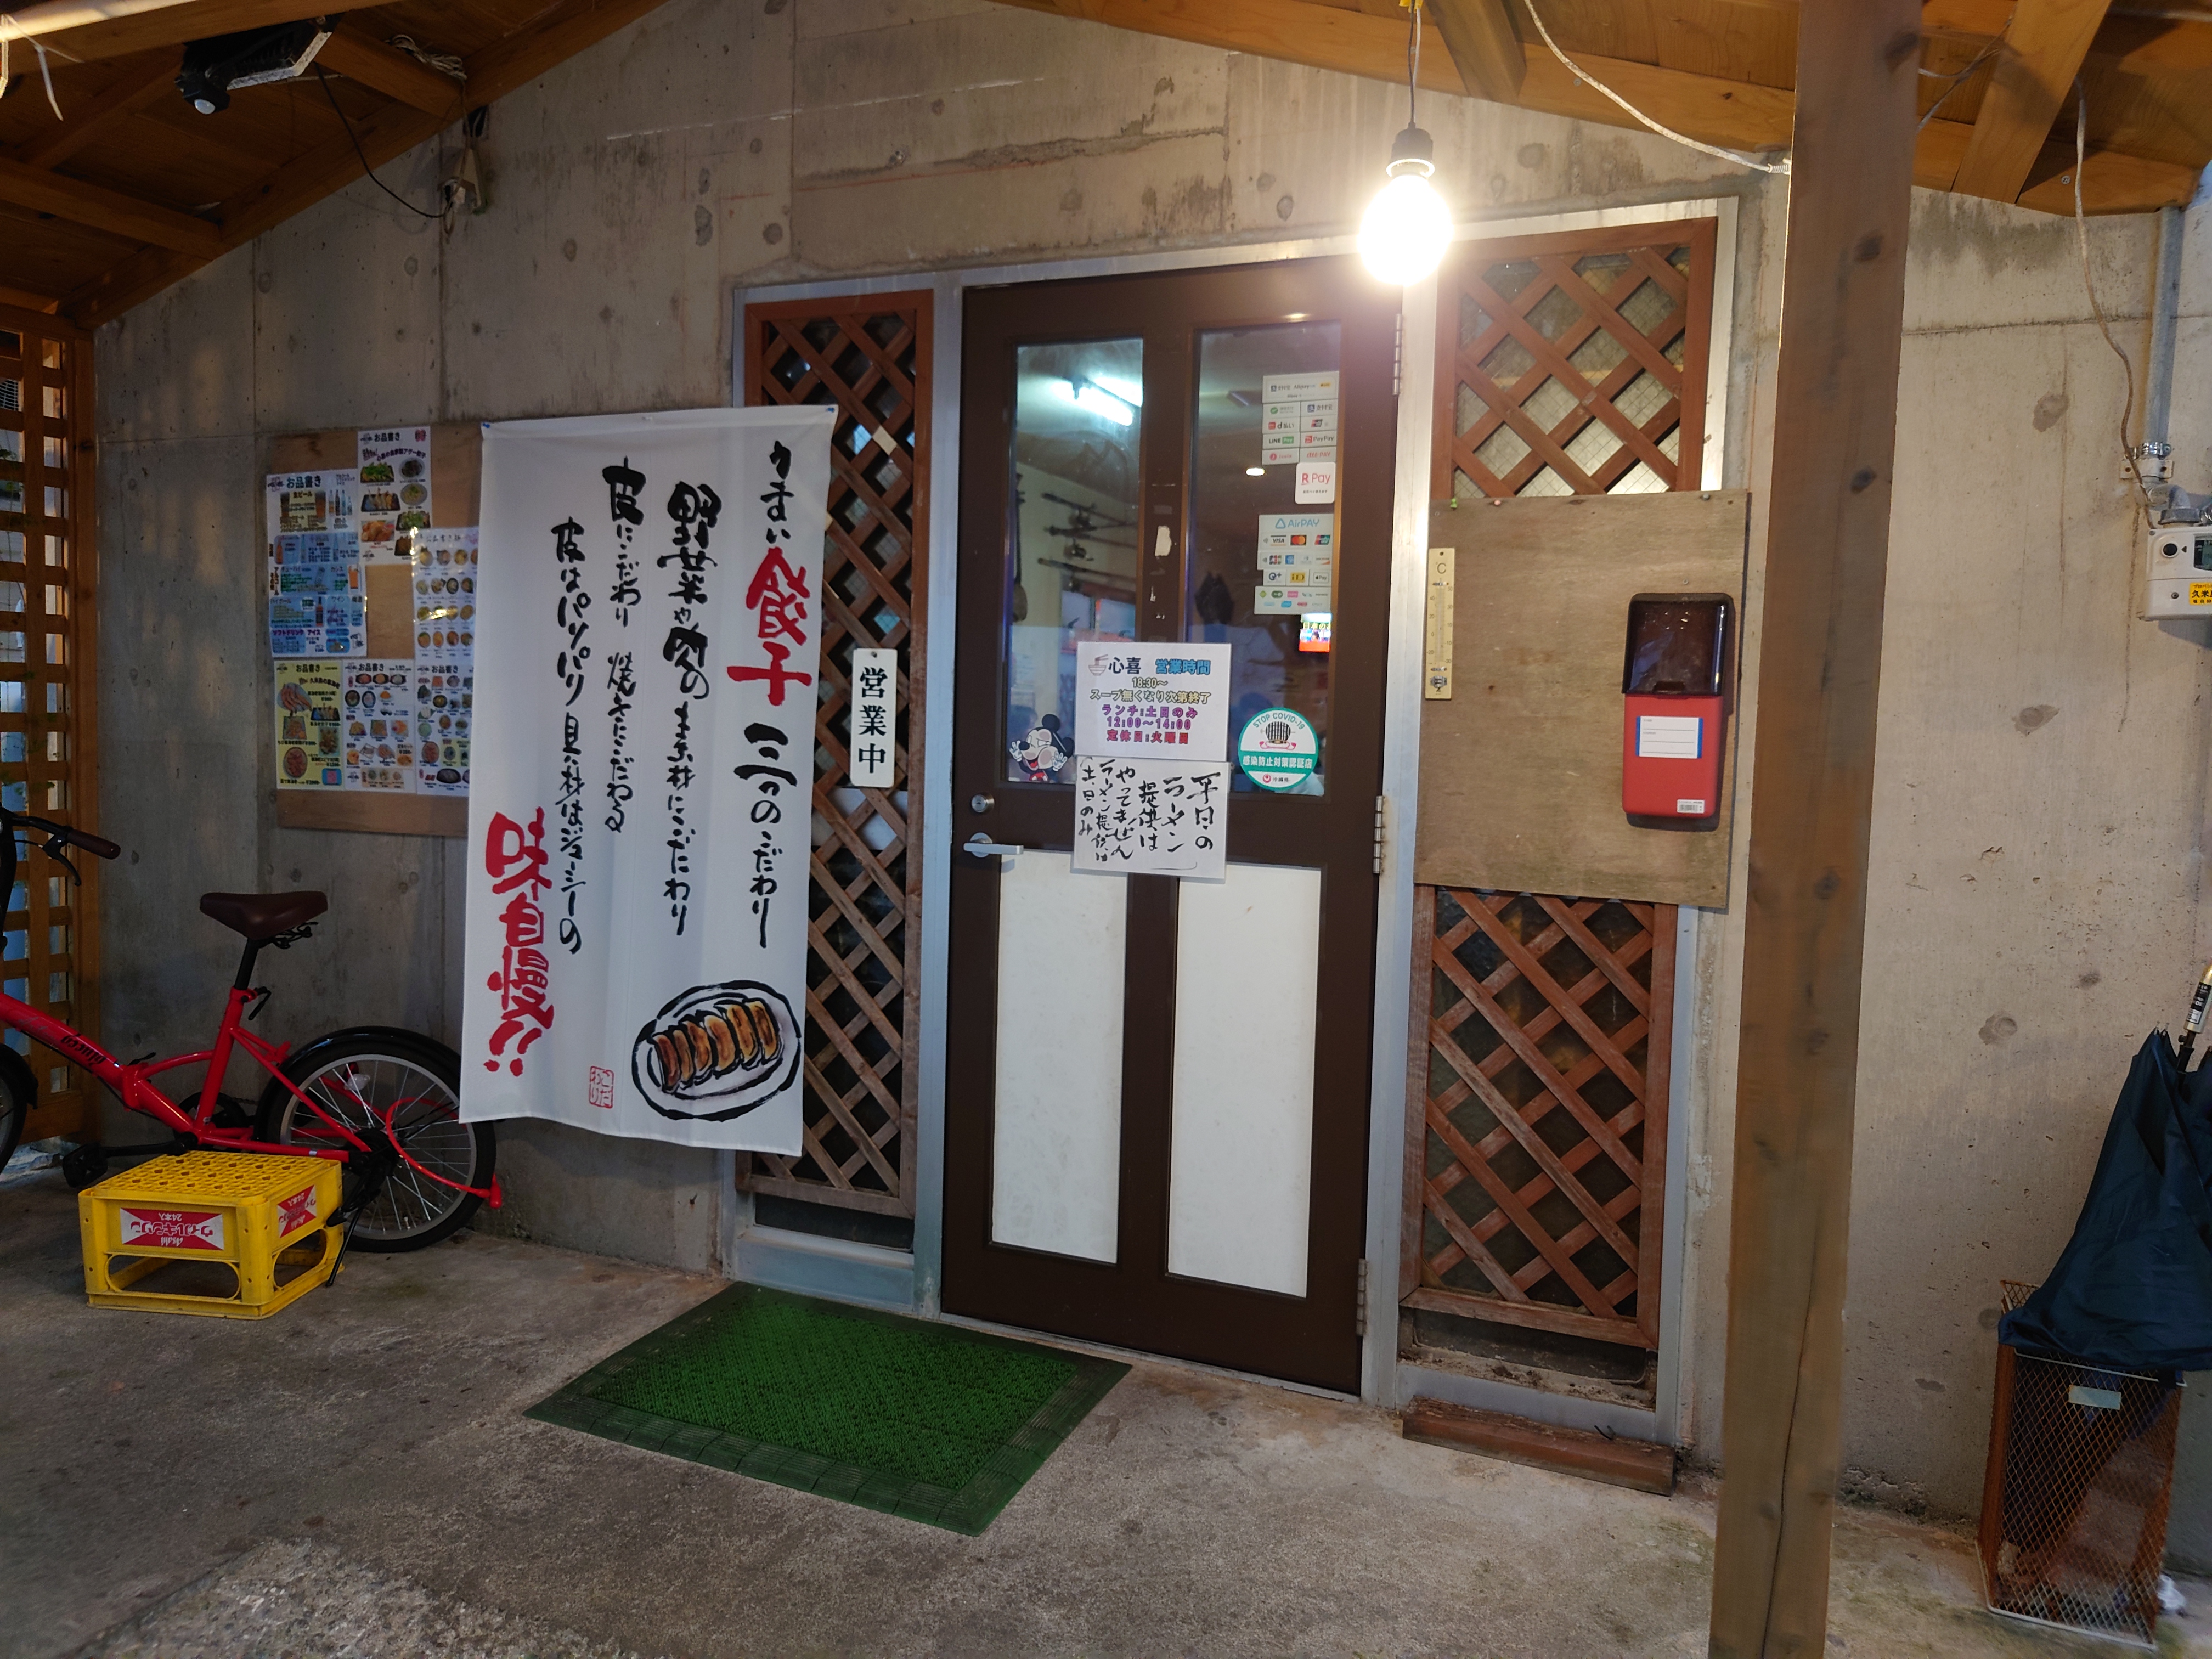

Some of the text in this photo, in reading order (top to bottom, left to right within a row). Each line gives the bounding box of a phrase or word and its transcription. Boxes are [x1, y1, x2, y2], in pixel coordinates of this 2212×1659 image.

[286, 475, 321, 488] お品書き
[1312, 473, 1330, 484] Pay
[1288, 519, 1319, 527] AirPAY
[1108, 657, 1211, 675] 心喜 営業時間
[1090, 689, 1211, 704] スープ無くなり次第終了
[859, 667, 888, 774] 営業中
[1253, 712, 1305, 730] STOP COVID-19
[1243, 755, 1313, 769] 感染防止対策認証店
[1161, 776, 1185, 852] ラーメン
[1186, 772, 1221, 850] 平日の
[158, 1212, 182, 1221] 24本入
[131, 1221, 213, 1237] ウィルキンソン
[161, 1237, 183, 1246] Asahi
